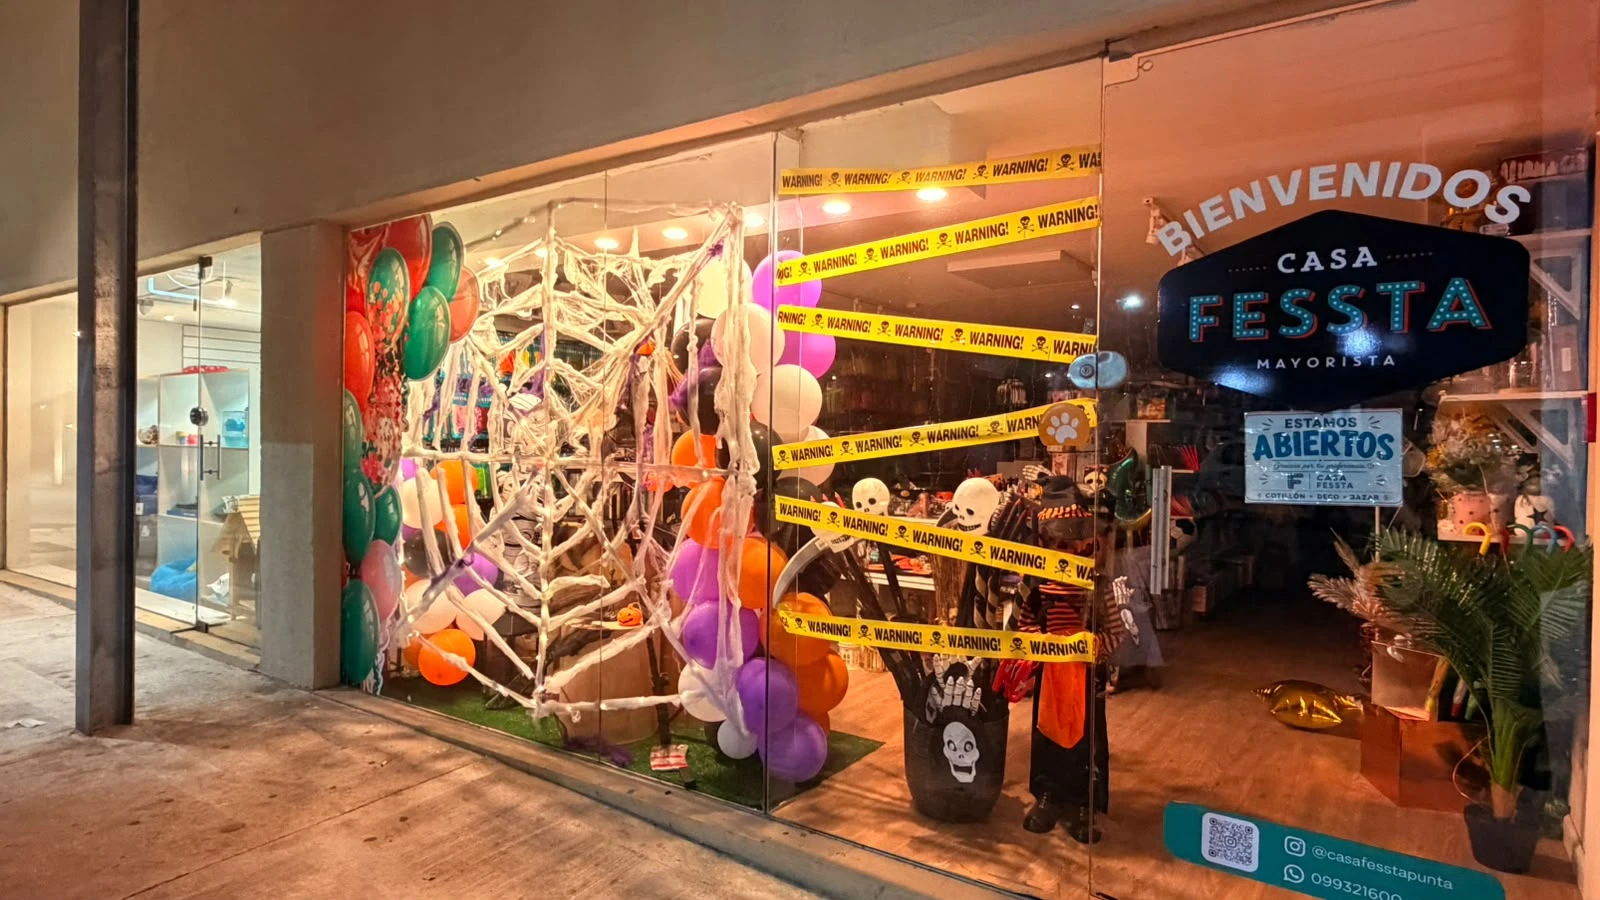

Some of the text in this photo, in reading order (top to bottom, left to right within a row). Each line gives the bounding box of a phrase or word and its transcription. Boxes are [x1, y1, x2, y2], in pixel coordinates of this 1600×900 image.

[782, 174, 823, 188] WARNING!
[844, 173, 892, 186] WARNING!
[915, 168, 967, 183] WARNING!
[992, 158, 1049, 176] WARNING!
[1155, 161, 1531, 257] BIENVENIDOS
[813, 253, 858, 274] WARNING!
[880, 238, 929, 260] WARNING!
[954, 222, 1009, 245] WARNING!
[1037, 204, 1099, 229] WARNING!
[1277, 246, 1377, 274] CASA
[1187, 277, 1492, 342] FESSTA
[827, 316, 872, 333] WARNING!
[895, 324, 944, 342] WARNING!
[969, 331, 1024, 350] WARNING!
[1257, 354, 1395, 370] MAYORISTA
[1284, 417, 1357, 429] ESTAMOS
[791, 444, 834, 462] WARNING!
[855, 435, 903, 453] WARNING!
[927, 425, 980, 443] WARNING!
[1253, 429, 1395, 461] ABIERTOS
[779, 503, 821, 522] WARNING!
[842, 516, 888, 536] WARNING!
[912, 530, 963, 552] WARNING!
[989, 545, 1046, 571] WARNING!
[808, 620, 851, 637] WARNING!
[874, 627, 922, 645] WARNING!
[948, 634, 1001, 651] WARNING!
[1030, 639, 1088, 655] WARNING!
[1312, 845, 1453, 890] @casafesstapunta
